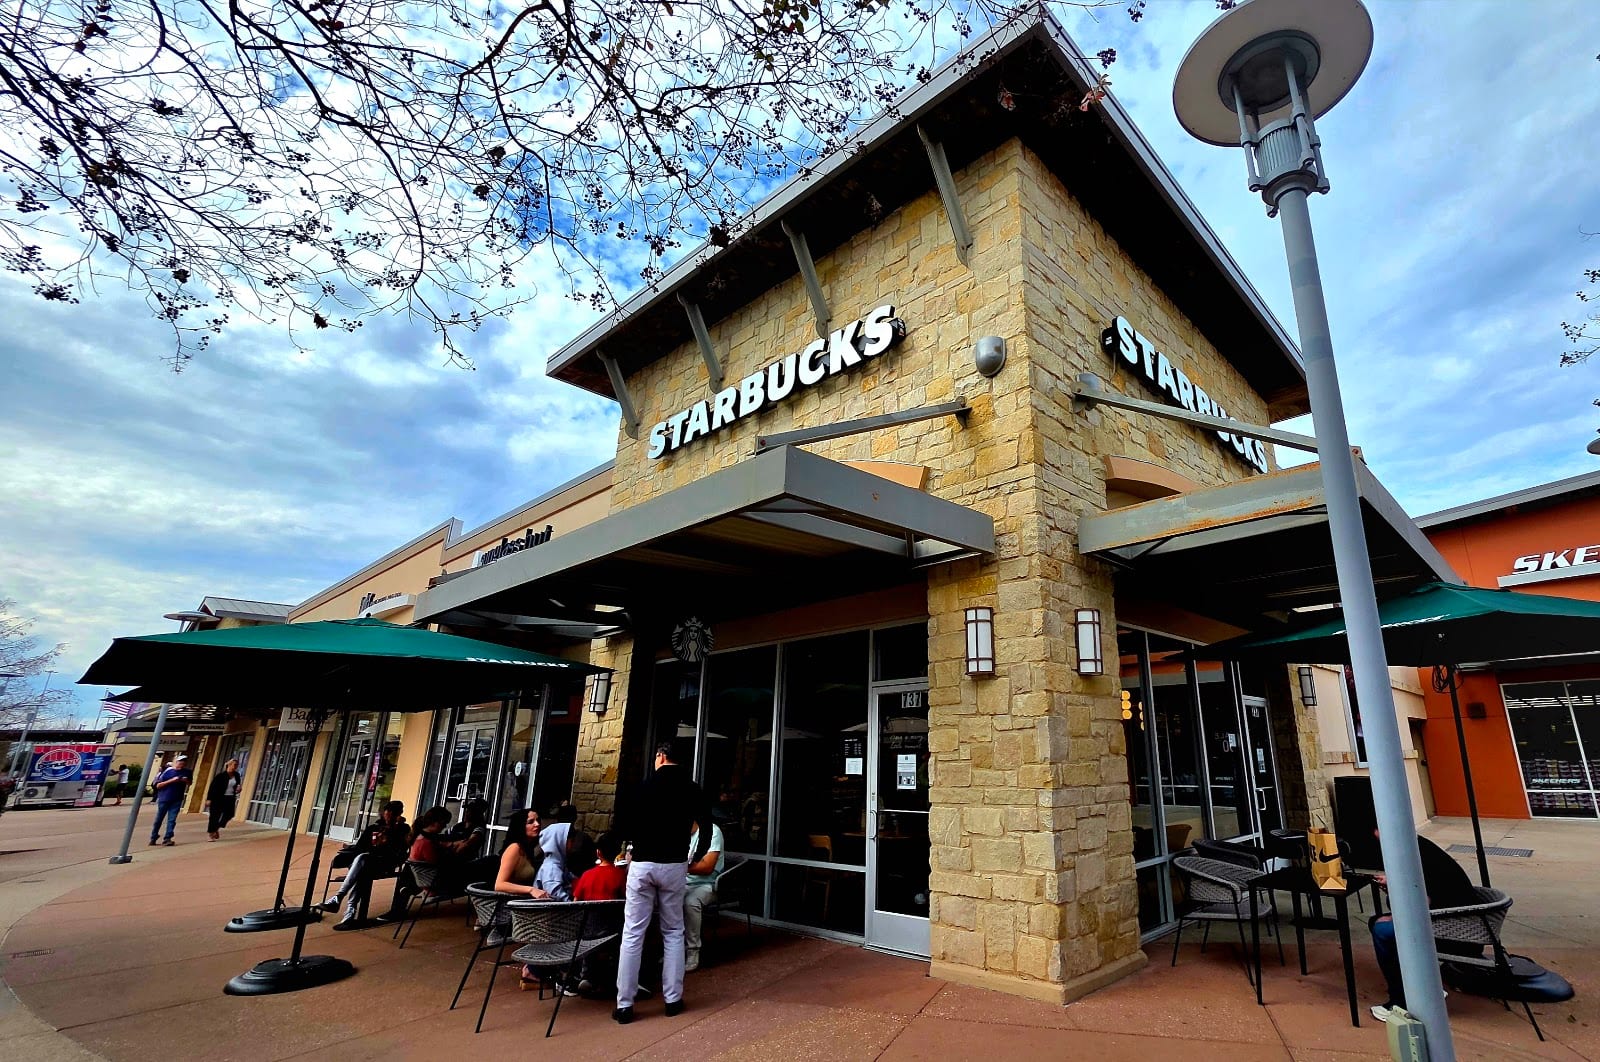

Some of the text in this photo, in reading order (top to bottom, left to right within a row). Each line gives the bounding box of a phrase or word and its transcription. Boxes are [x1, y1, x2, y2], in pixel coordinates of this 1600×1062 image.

[647, 305, 896, 460] STARBUCKS
[1512, 544, 1600, 575] SKE
[902, 692, 921, 707] 737
